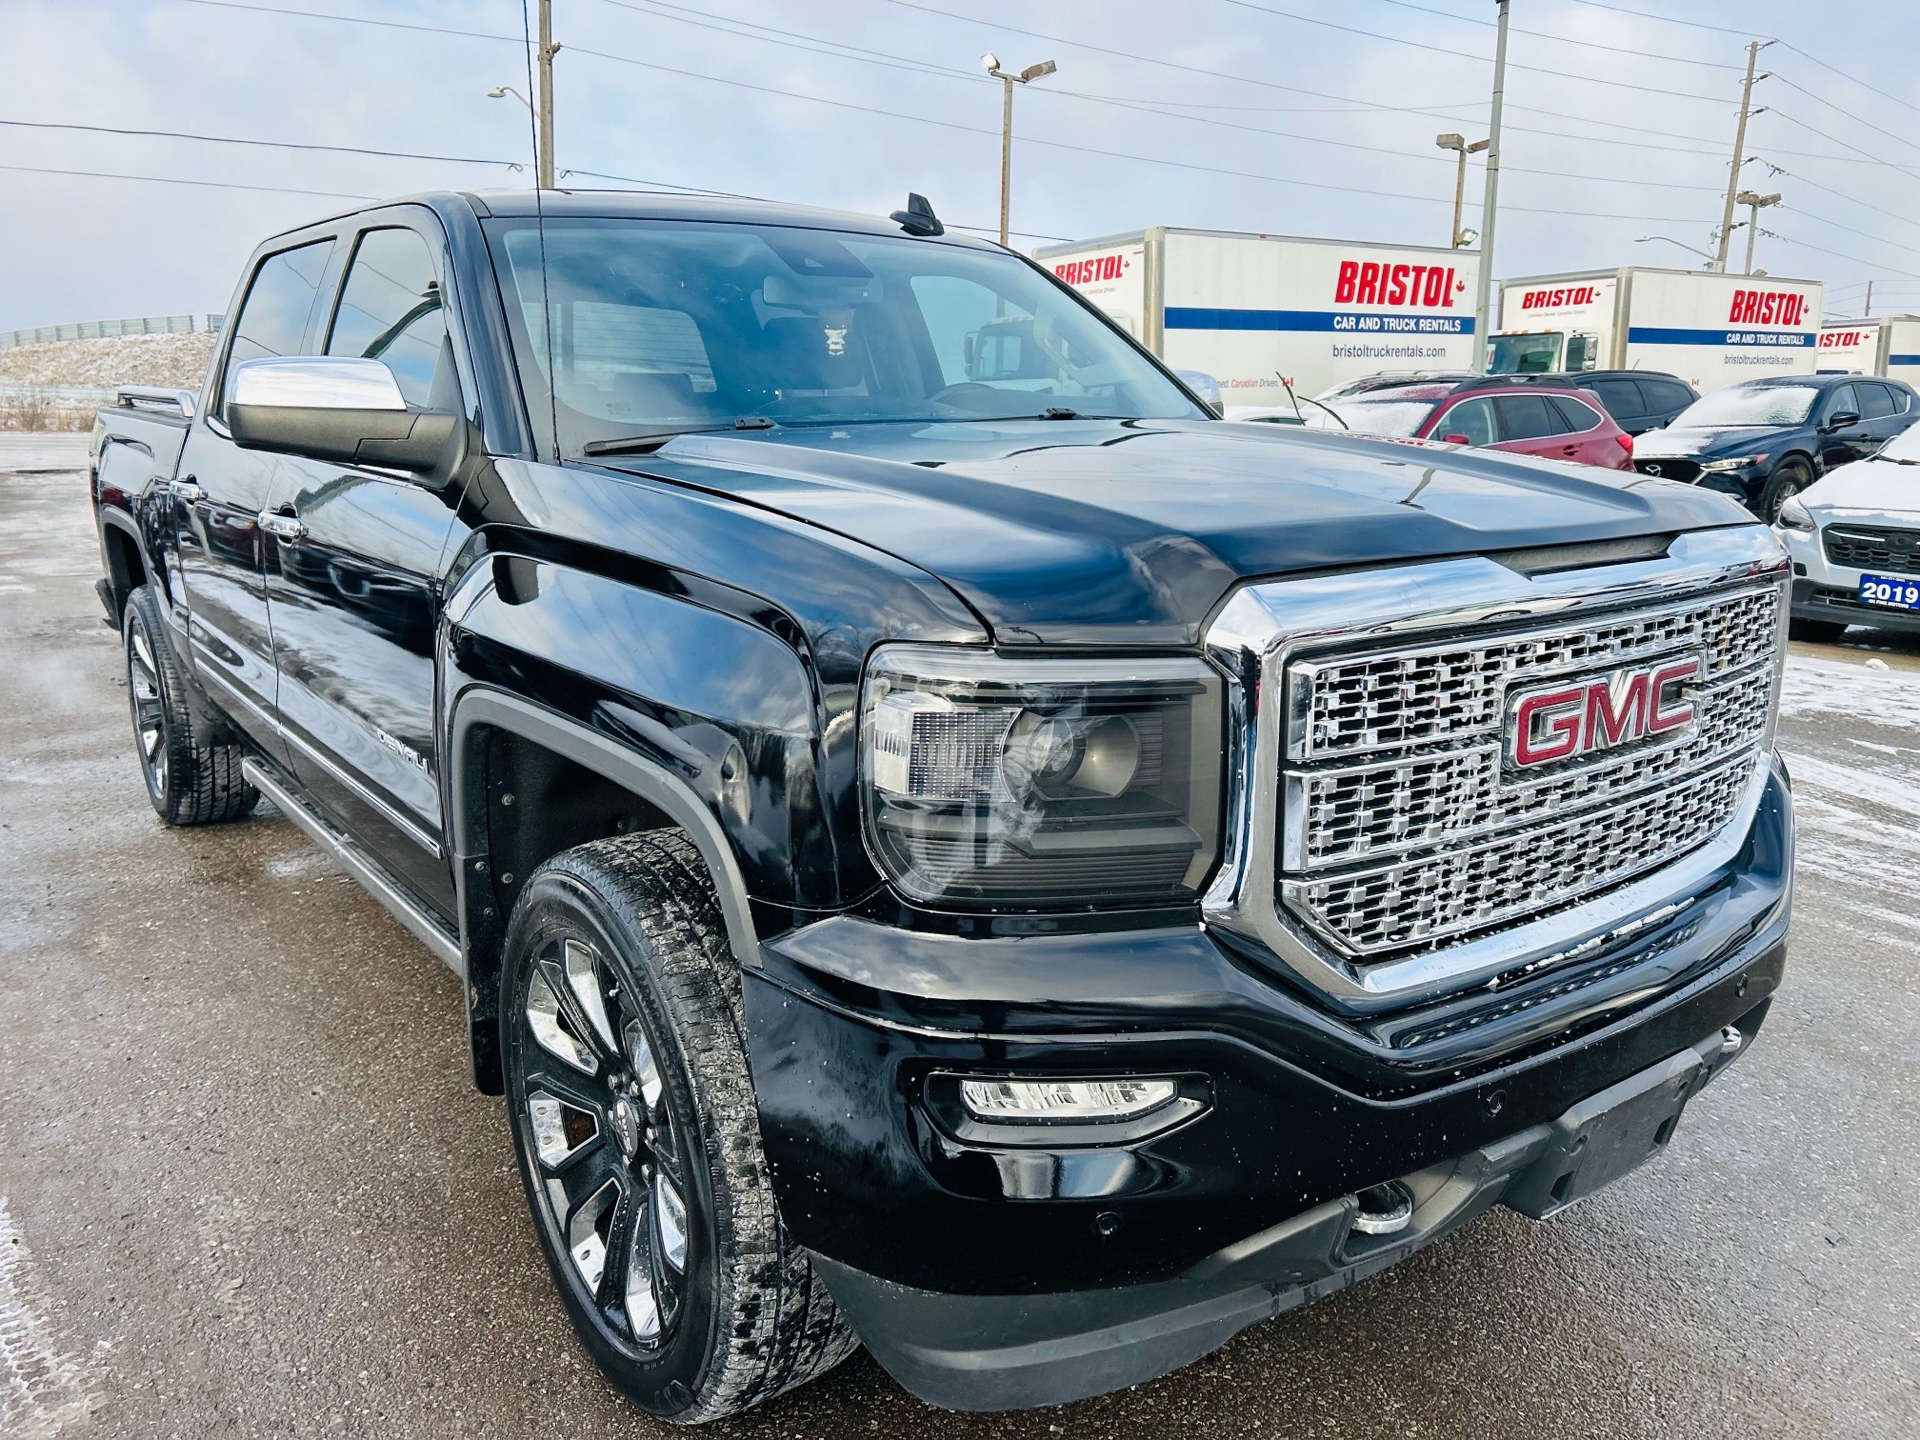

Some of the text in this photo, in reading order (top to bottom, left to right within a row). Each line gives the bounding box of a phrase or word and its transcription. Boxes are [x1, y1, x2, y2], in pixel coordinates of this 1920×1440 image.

[1334, 260, 1455, 308] BRISTOL
[1521, 286, 1595, 310] BRISTOL
[1728, 289, 1805, 326] BRISTOL
[1333, 316, 1461, 332] CAR AND TRUCK RENTALS
[1726, 332, 1805, 345] CAR AND TRUCK RENTALS
[1818, 332, 1860, 347] ISTOL
[1332, 344, 1446, 358] bristoltruckrentals.com
[1724, 354, 1794, 365] bristoltruckrentals.com
[1230, 379, 1258, 388] Canadian
[1861, 582, 1919, 604] 2019
[1515, 656, 1700, 767] GMC
[377, 728, 430, 774] DENALI
